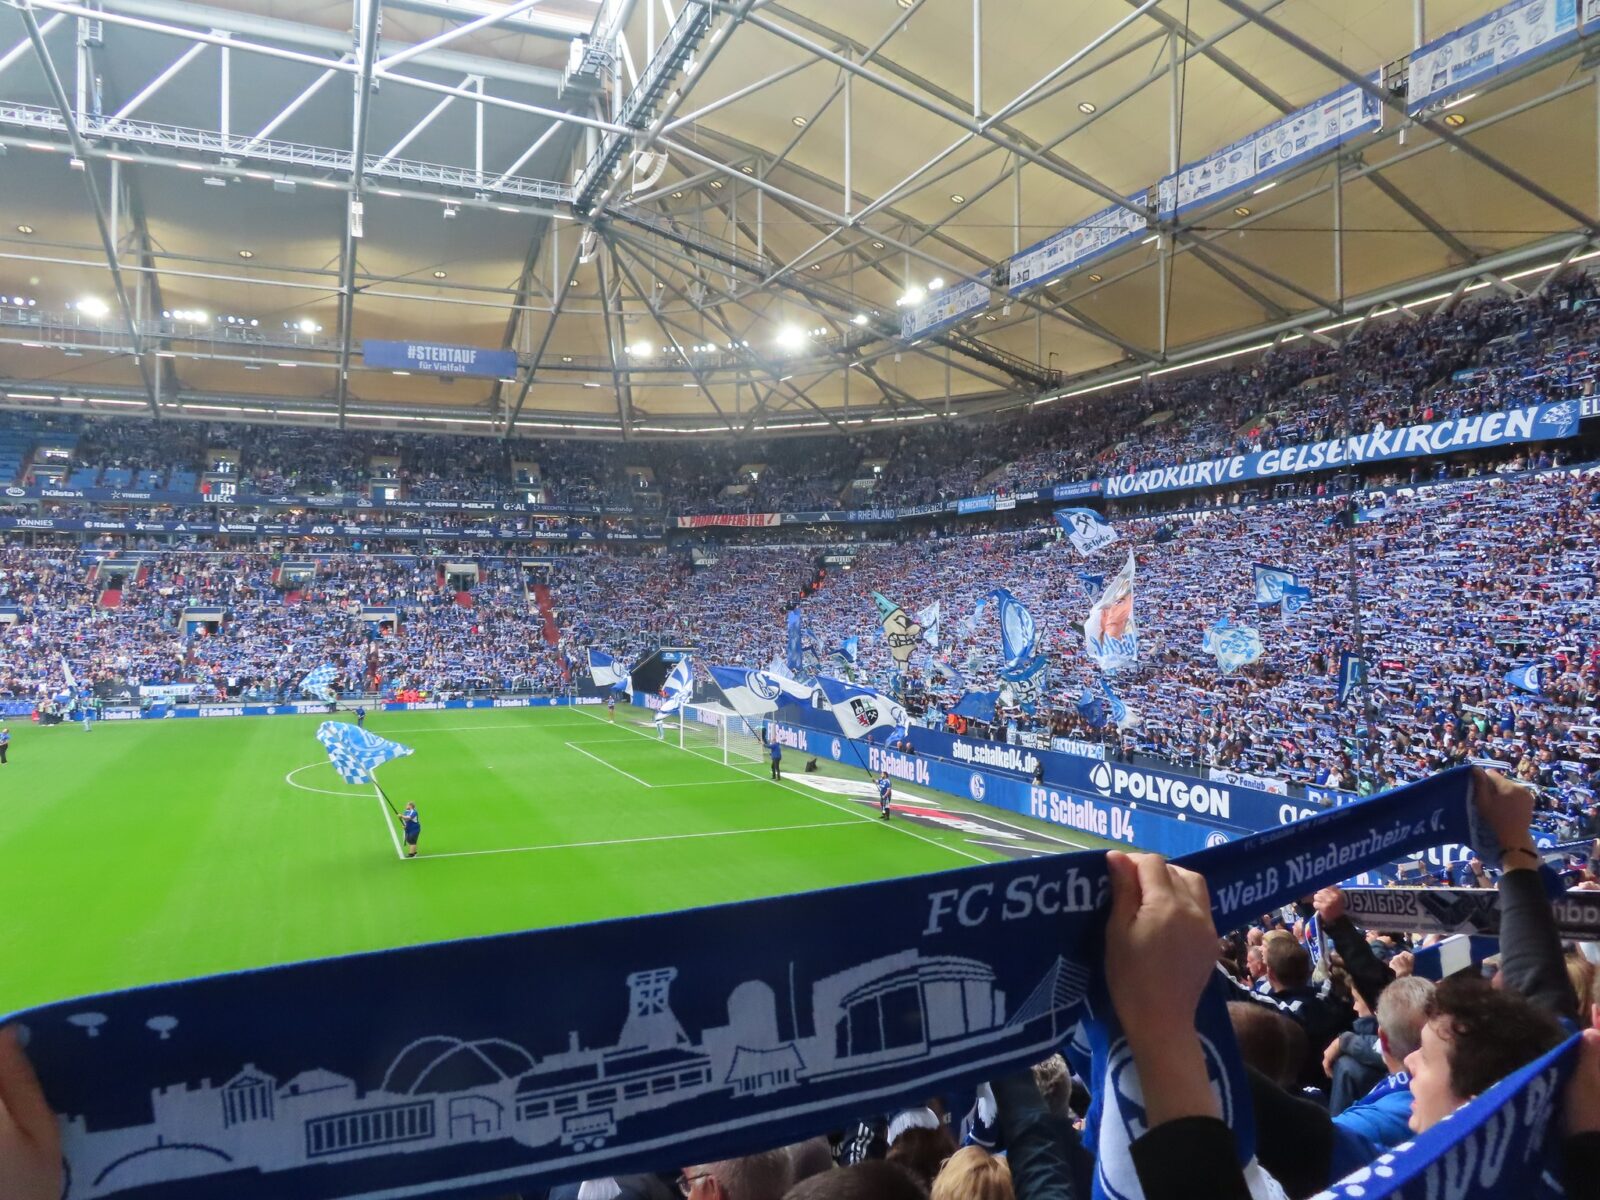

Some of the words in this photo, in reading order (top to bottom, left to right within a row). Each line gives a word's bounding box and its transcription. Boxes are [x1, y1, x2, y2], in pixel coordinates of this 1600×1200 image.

[407, 345, 477, 364] #STEHTAUF
[434, 363, 466, 373] Vielfalt
[1106, 455, 1245, 496] NORDKURVE
[1256, 406, 1539, 475] GELSENKIRCHEN
[15, 518, 54, 527] TÖNNIES
[311, 526, 335, 534] AVG
[857, 508, 895, 520] RHEINLAND
[776, 724, 798, 748] Schalke
[798, 729, 807, 751] 04
[869, 747, 880, 772] FC
[881, 750, 915, 782] Schalke
[916, 760, 930, 786] 04
[952, 739, 1038, 774] shop.schalke04.de
[1114, 768, 1230, 819] POLYGON
[1031, 787, 1047, 819] FC
[1050, 792, 1107, 835] Schalke
[1110, 809, 1134, 843] 04
[1285, 820, 1411, 888] Niederrhein
[922, 881, 996, 936] FC
